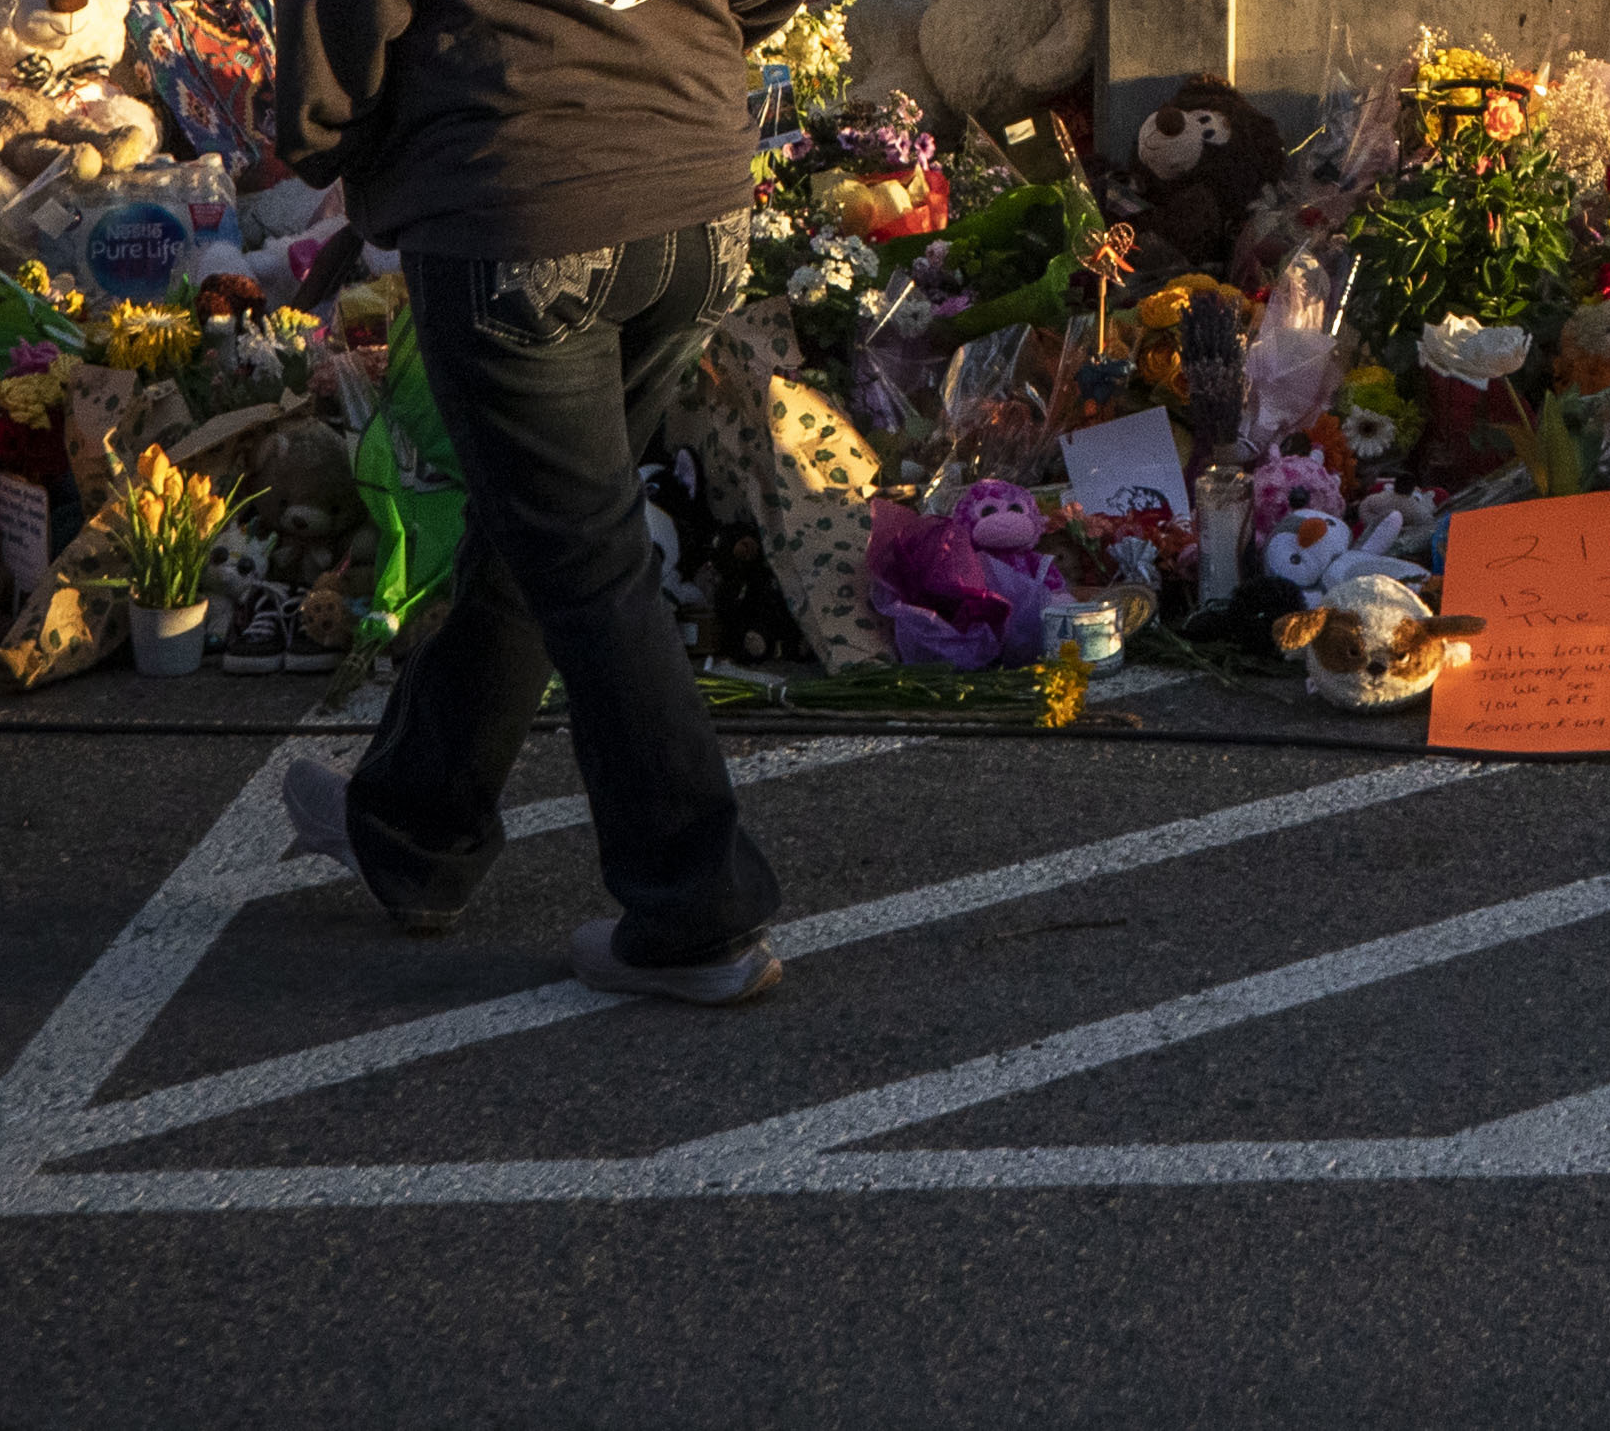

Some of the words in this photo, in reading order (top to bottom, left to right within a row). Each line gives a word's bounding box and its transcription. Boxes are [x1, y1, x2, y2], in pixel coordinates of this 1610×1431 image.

[91, 240, 143, 260] Pure
[146, 238, 184, 265] Life
[1508, 607, 1592, 627] The
[1473, 645, 1536, 662] With
